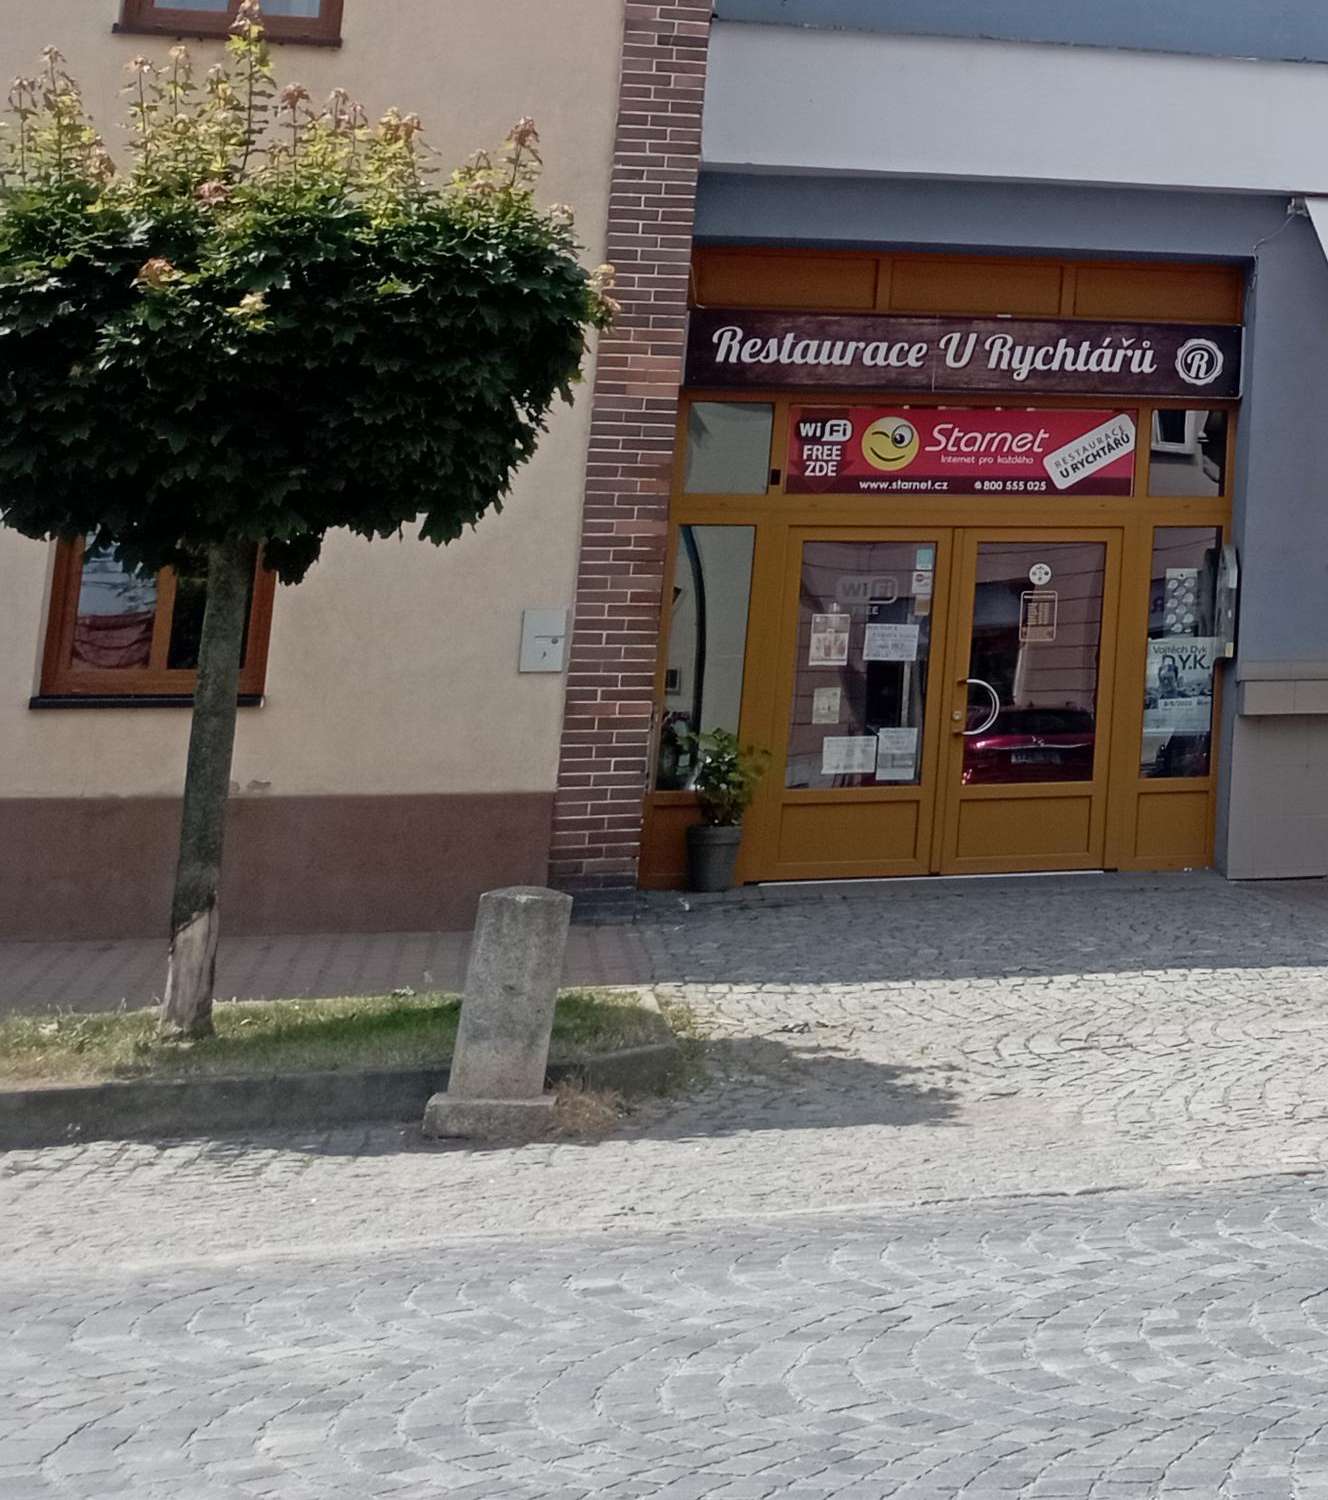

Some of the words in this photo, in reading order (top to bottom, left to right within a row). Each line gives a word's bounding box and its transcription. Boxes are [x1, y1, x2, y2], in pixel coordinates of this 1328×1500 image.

[712, 326, 928, 367] Restaurace
[939, 332, 978, 368] U
[985, 333, 1157, 382] Rychtářů
[925, 423, 1050, 453] Starnet
[803, 444, 841, 460] FREE
[1054, 424, 1125, 469] RESTAURACE
[941, 454, 975, 464] Internet
[979, 457, 994, 466] pro
[804, 461, 837, 477] ZDE
[1060, 467, 1070, 478] U
[859, 479, 949, 490] www.starnet.cz
[983, 480, 1003, 491] 800
[1005, 481, 1025, 491] 555
[1027, 481, 1046, 491] 025
